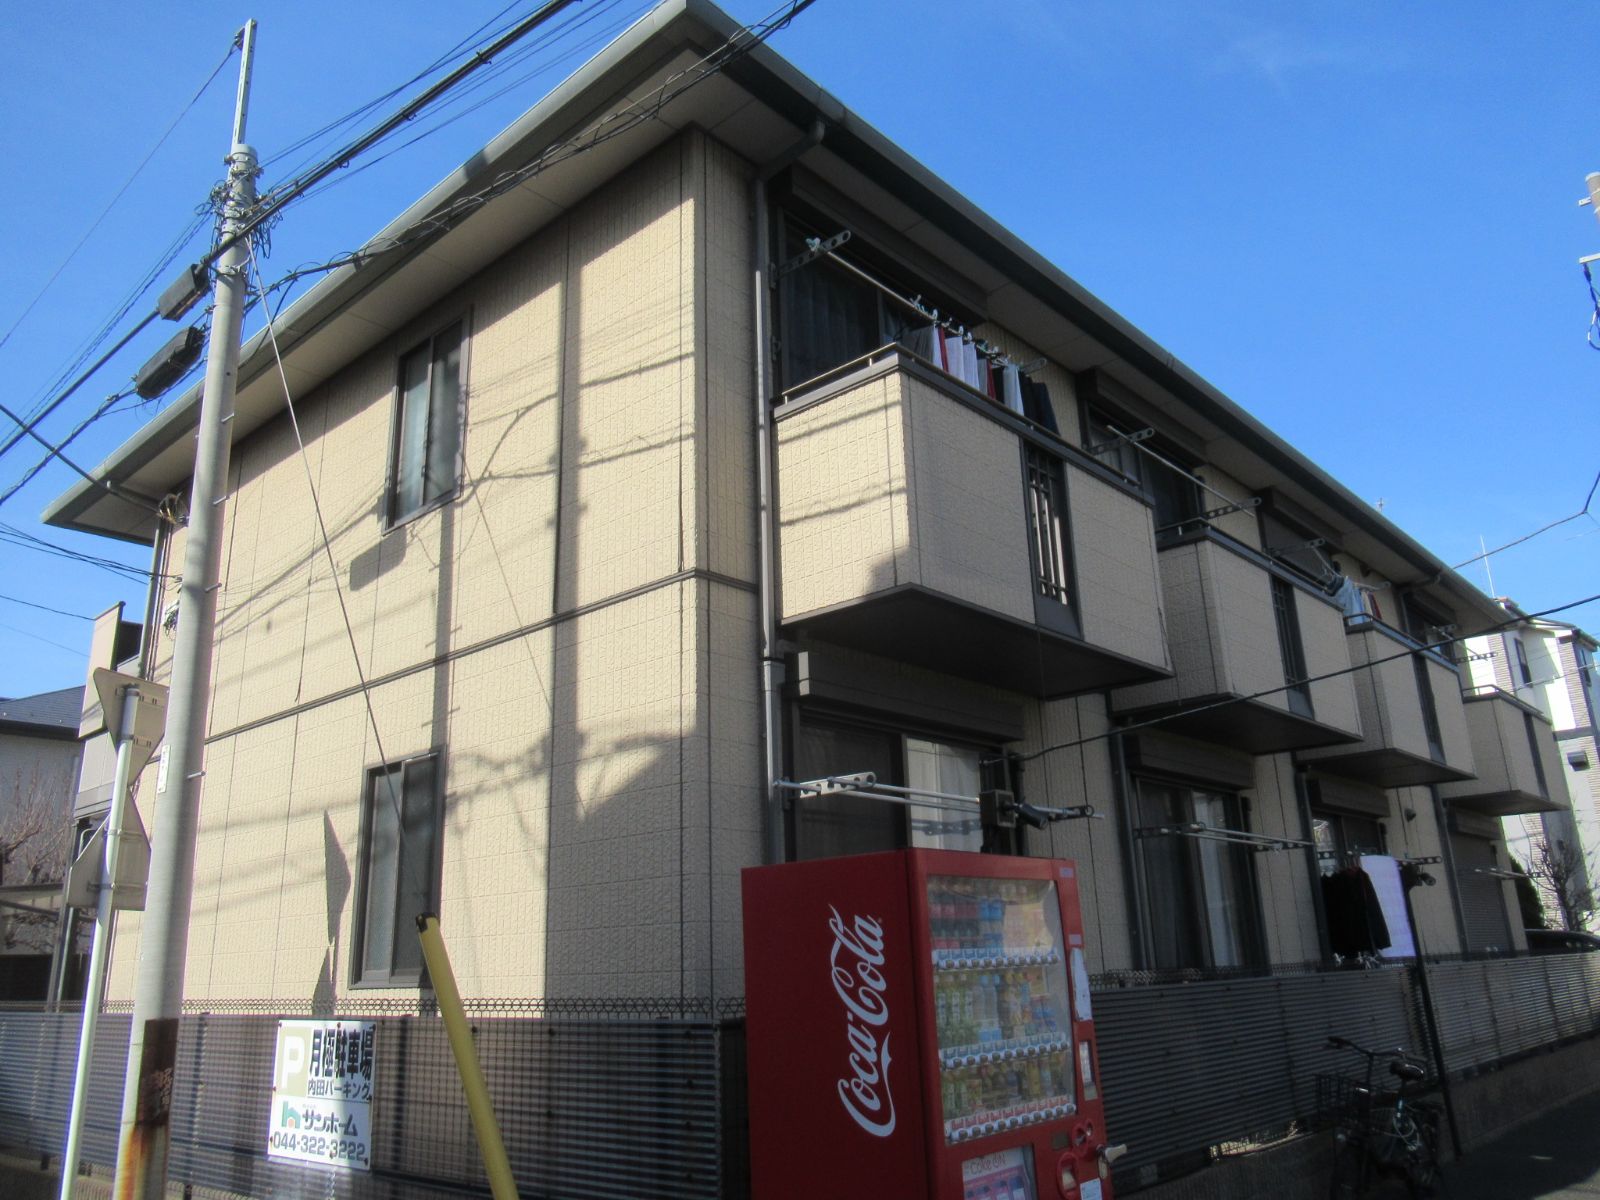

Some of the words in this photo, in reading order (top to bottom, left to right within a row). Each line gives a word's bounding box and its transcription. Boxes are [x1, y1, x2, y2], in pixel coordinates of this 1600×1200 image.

[828, 903, 896, 1138] Coca-Cola
[281, 1035, 305, 1092] P
[309, 1029, 375, 1082] 月極駐車場
[307, 1078, 372, 1101] 内田パーキング
[302, 1108, 358, 1137] サンホーム
